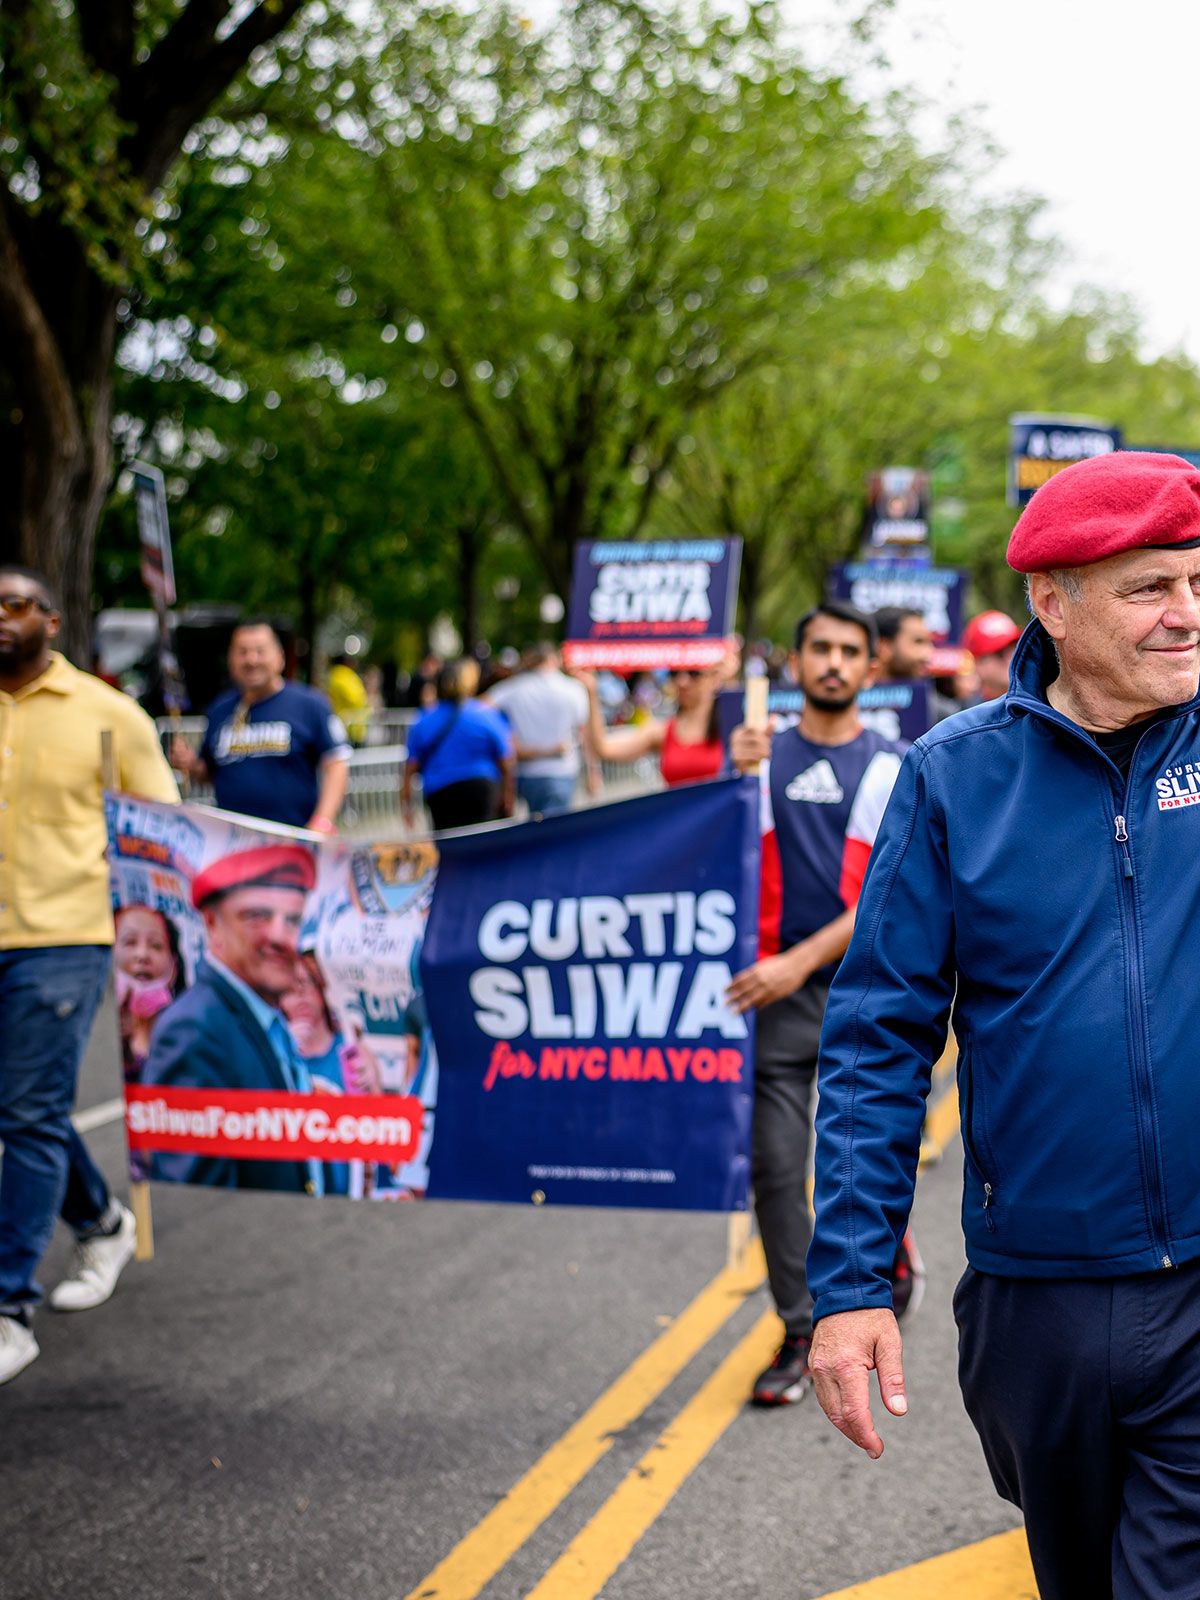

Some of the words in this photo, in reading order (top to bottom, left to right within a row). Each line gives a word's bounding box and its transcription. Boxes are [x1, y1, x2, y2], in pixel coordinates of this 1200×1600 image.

[1160, 800, 1181, 809] FOR
[478, 889, 737, 964] CURTIS
[468, 961, 748, 1040] SLIWA
[482, 1039, 538, 1093] for
[538, 1046, 609, 1082] NYC
[609, 1046, 744, 1083] MAYOR
[127, 1098, 412, 1147] SliwaForNYC.com
